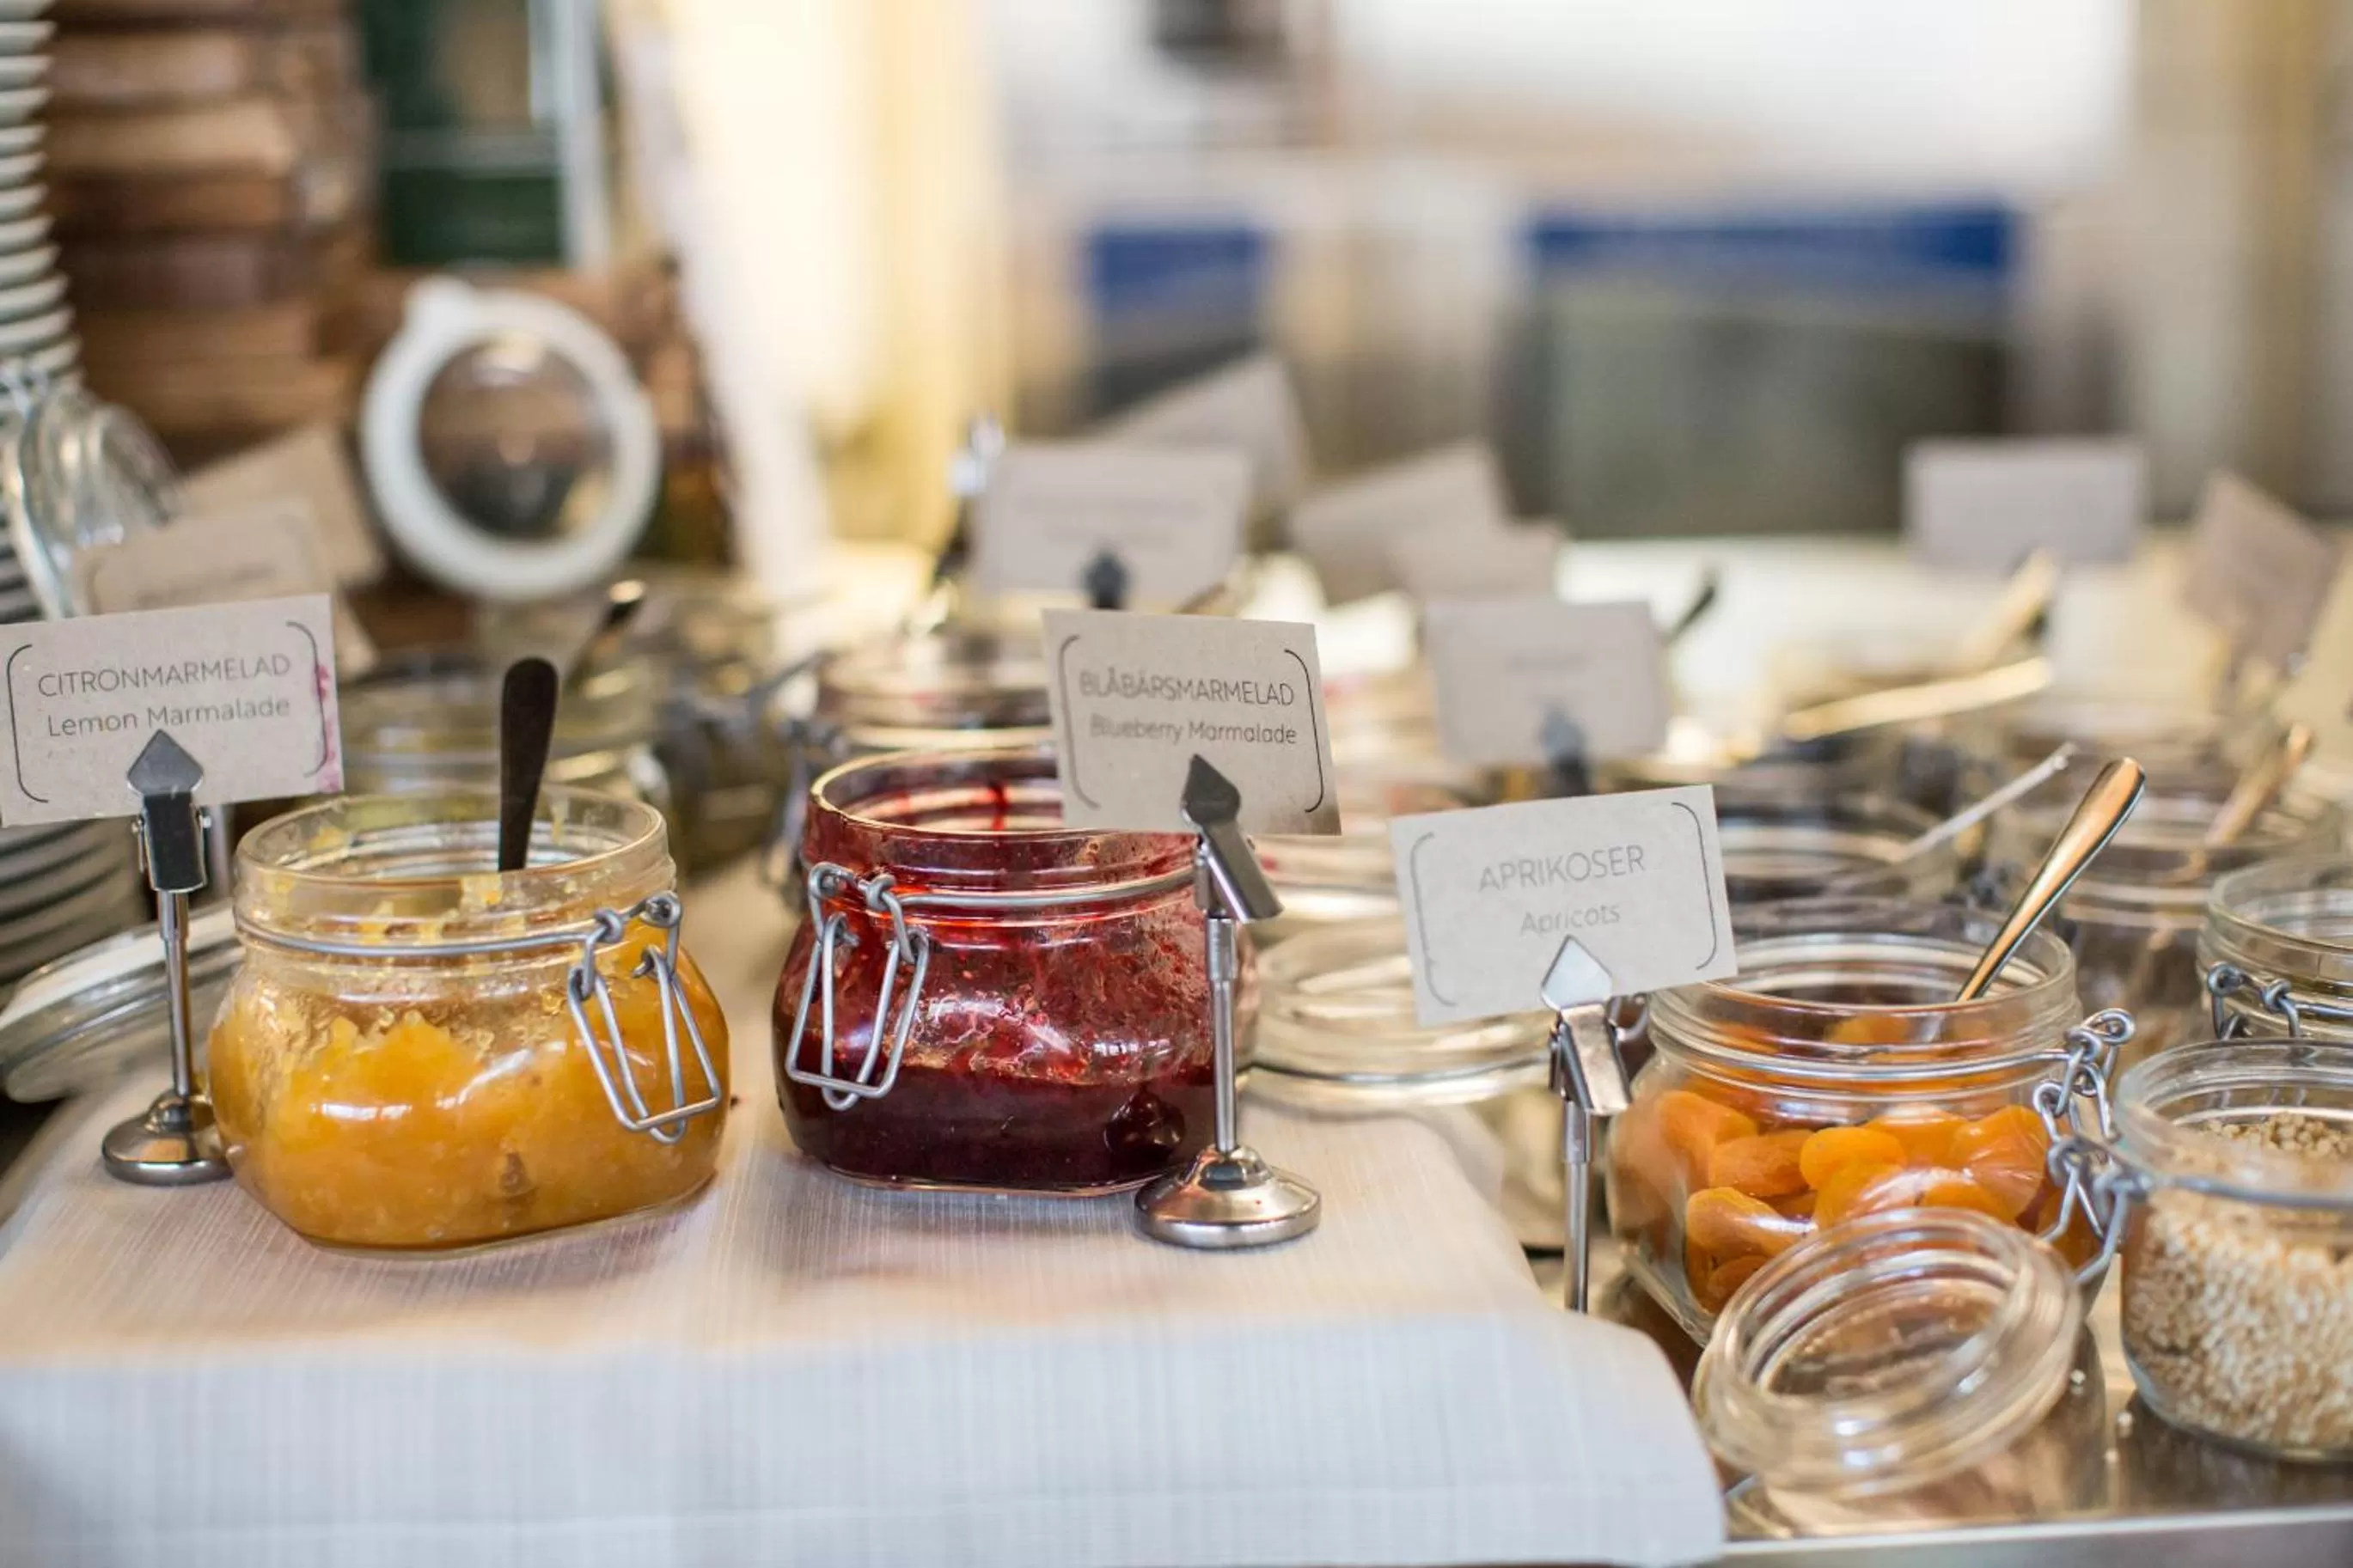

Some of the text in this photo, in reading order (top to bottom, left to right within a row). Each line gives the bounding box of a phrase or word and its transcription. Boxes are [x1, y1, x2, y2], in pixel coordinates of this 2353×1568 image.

[37, 653, 291, 697] CITRONMARMELAD
[48, 697, 290, 737] Lemon Marmalade
[1188, 720, 1298, 745] Marmalade
[1479, 845, 1646, 892] APRIKOSER
[1520, 904, 1621, 936] Apricots
